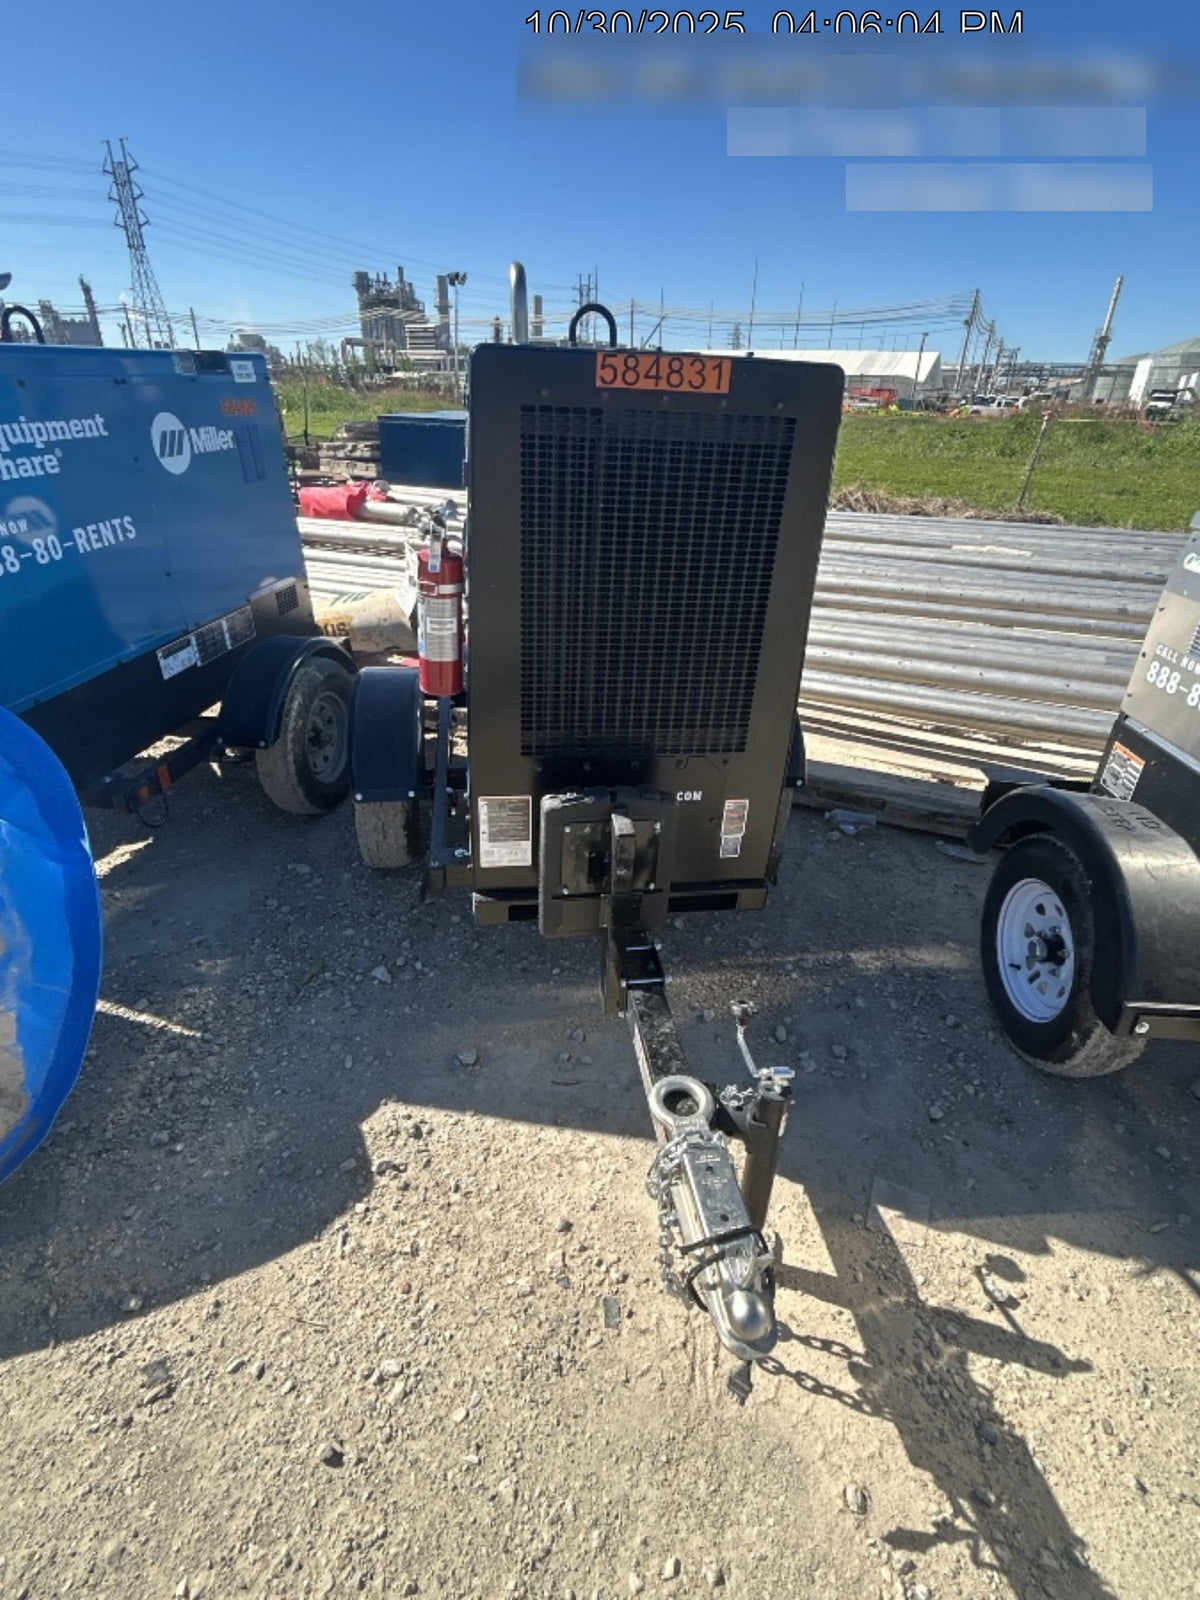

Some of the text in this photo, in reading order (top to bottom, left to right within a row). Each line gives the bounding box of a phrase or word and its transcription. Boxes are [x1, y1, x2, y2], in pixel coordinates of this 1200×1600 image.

[600, 353, 724, 390] 584831
[189, 426, 234, 454] Miller
[1156, 644, 1178, 664] CALL
[1146, 660, 1200, 712] 888-8
